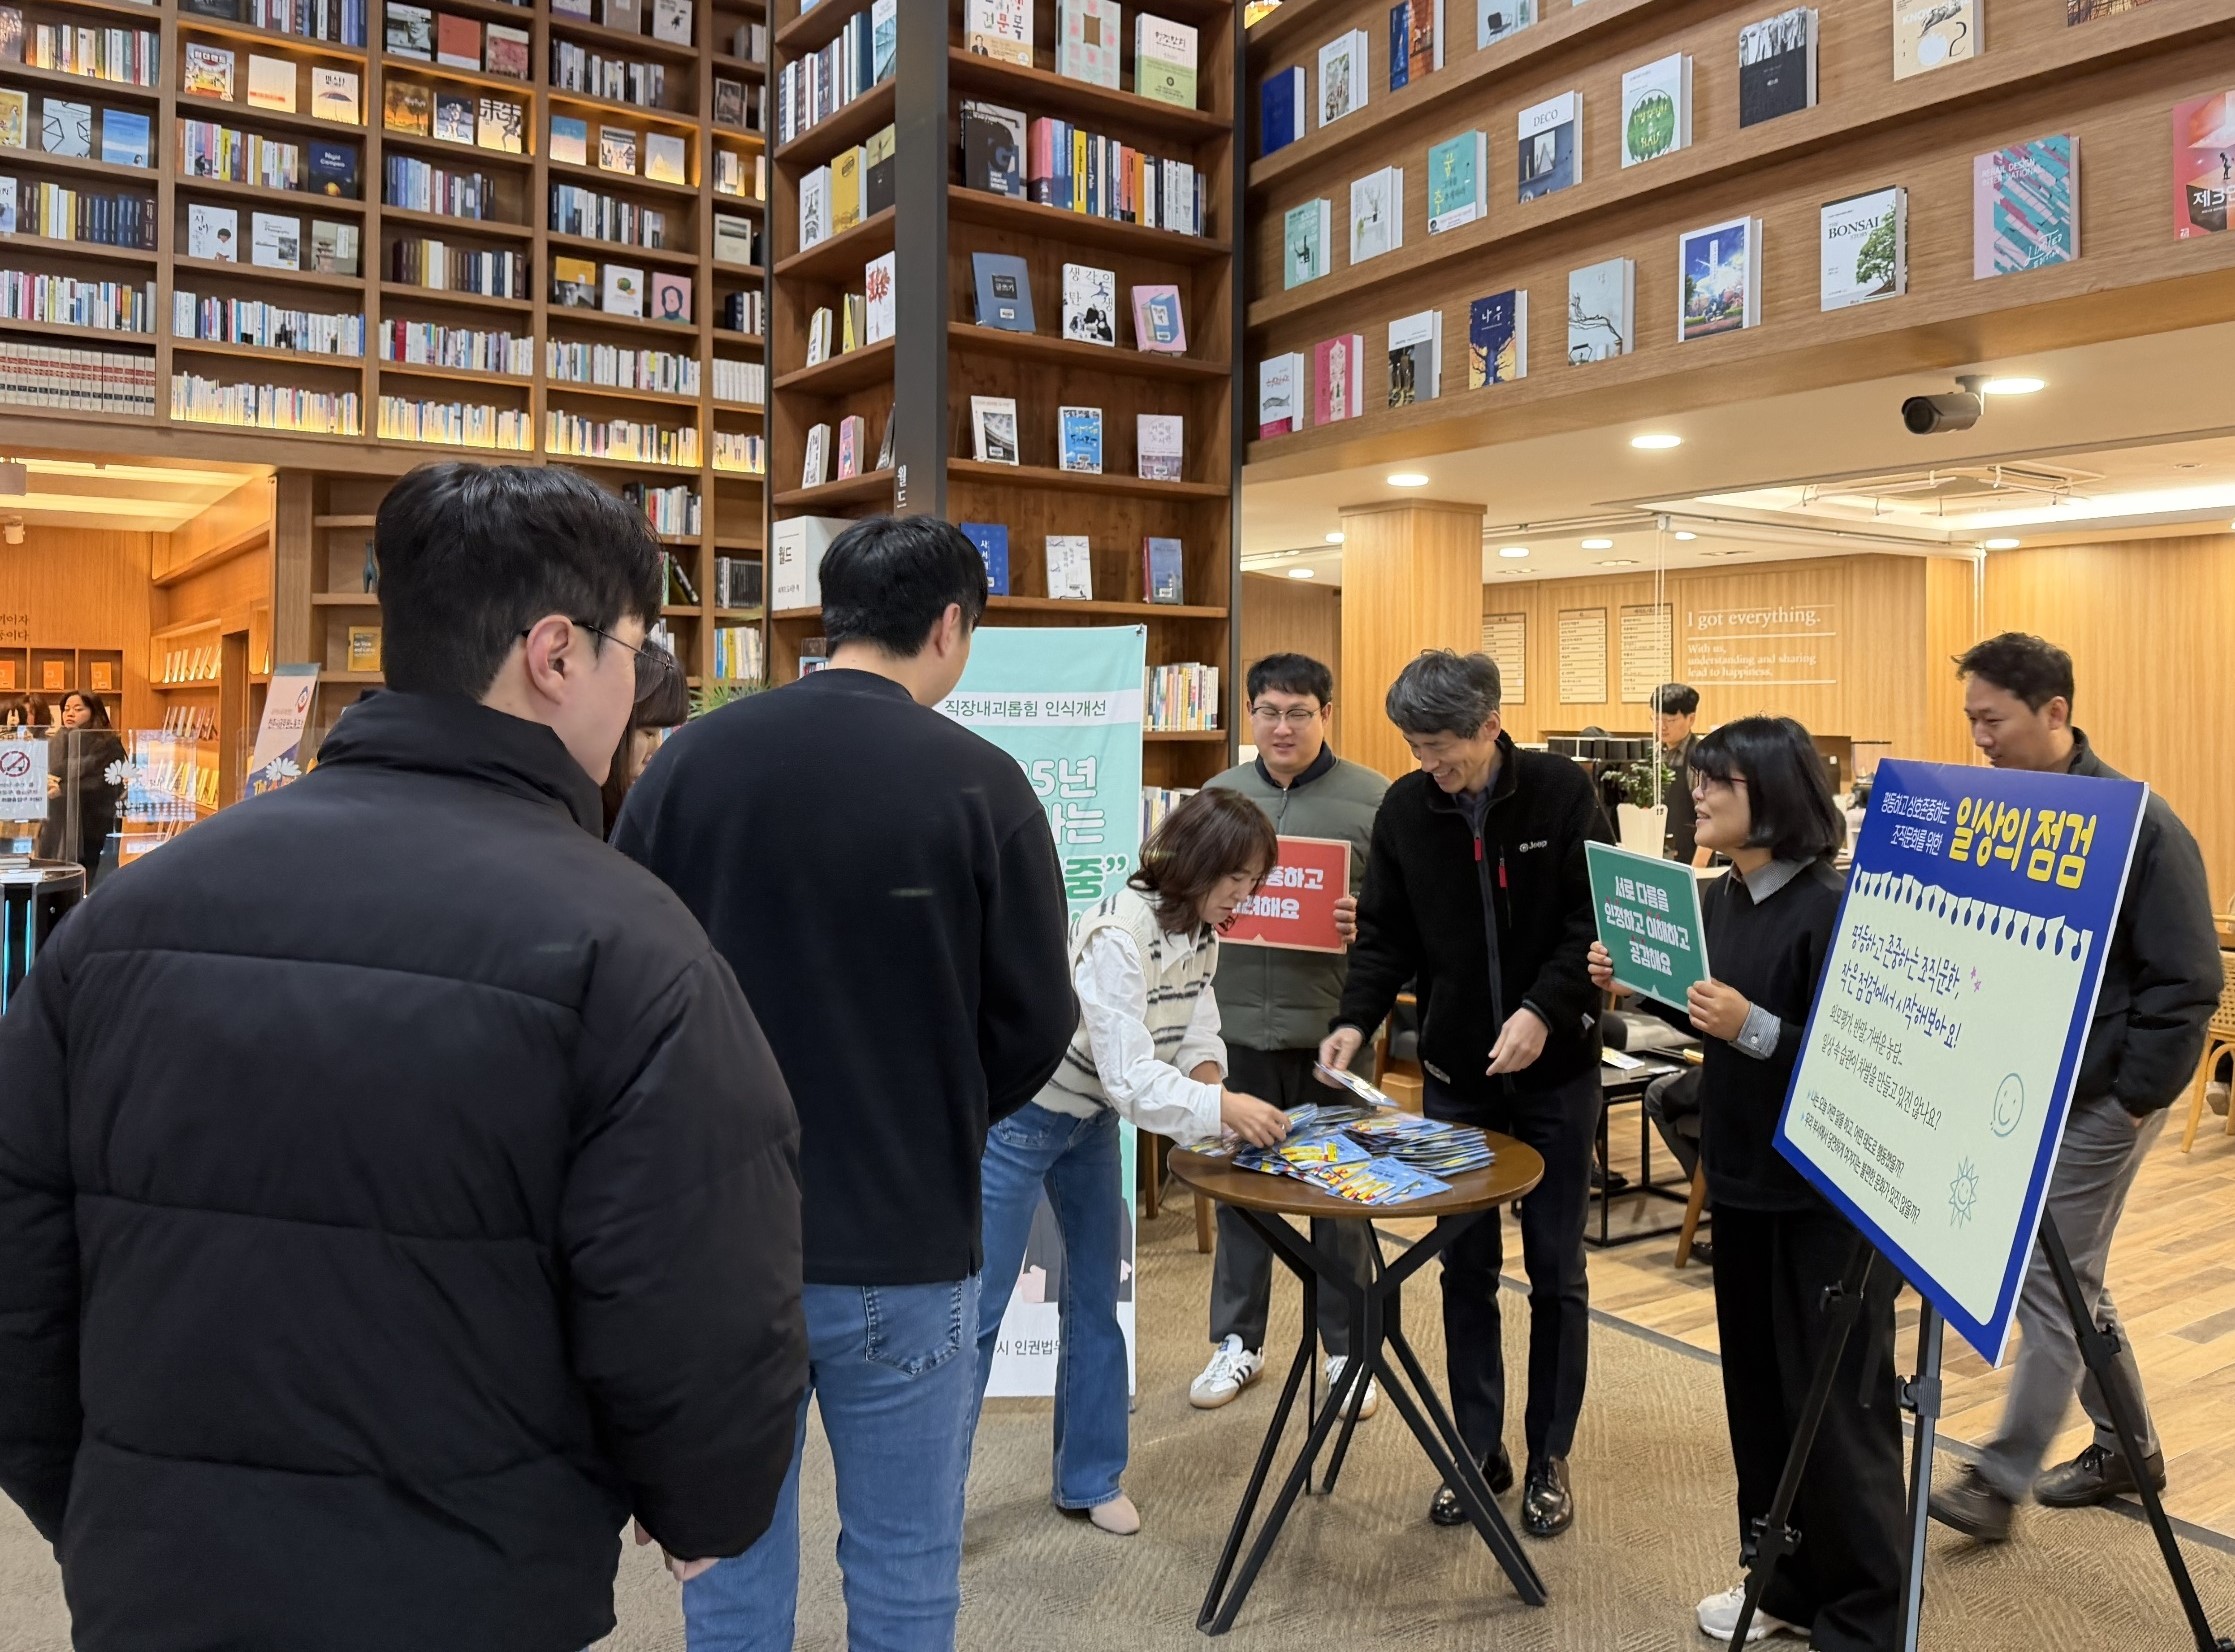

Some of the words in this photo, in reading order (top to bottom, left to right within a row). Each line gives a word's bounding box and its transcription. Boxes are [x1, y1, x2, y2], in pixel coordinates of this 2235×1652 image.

[1533, 109, 1559, 127] DECO
[2008, 158, 2035, 171] DESIGN
[1828, 216, 1879, 239] BONSAI
[1069, 267, 1113, 285] 생각의
[1069, 291, 1112, 312] 탄생
[778, 546, 792, 565] 월드
[1688, 611, 1693, 627] I
[1698, 612, 1723, 630] got
[1729, 606, 1821, 628] everything.
[1688, 643, 1710, 654] With
[1688, 654, 1755, 665] understanding
[1757, 654, 1775, 664] and
[1779, 654, 1816, 666] sharing
[1688, 668, 1707, 677] lead
[1710, 668, 1720, 677] to
[1722, 667, 1774, 679] happiness.
[945, 699, 1038, 717] 직장내괴롭힘
[1045, 699, 1106, 717] 인식개선
[1882, 792, 1909, 815] 평등하고
[1891, 825, 1927, 851] 조직문화를
[1926, 832, 1943, 855] 위한
[1950, 796, 2031, 871] 일상의
[2027, 808, 2097, 889] 점검
[1266, 866, 1324, 890] 중하고
[1615, 875, 1636, 901] 서로
[1636, 881, 1669, 912] 다름을
[1604, 902, 1645, 935] 인정하고
[1646, 915, 1690, 951] 이해하고
[1629, 940, 1672, 976] 공감해요
[1852, 925, 1884, 960] 평등하고
[1883, 934, 1918, 980] 존중하는
[1918, 956, 1961, 1000] 조직문화,
[1841, 960, 1858, 994] 작은
[1856, 971, 1896, 1008] 점검에서
[1867, 1027, 1886, 1055] 가벼운
[1822, 1034, 1834, 1056] 일상
[1834, 1041, 1840, 1058] 속
[1839, 1046, 1859, 1073] 습관이
[1857, 1059, 1876, 1087] 차별을
[1877, 1072, 1898, 1099] 만들고
[1896, 1086, 1913, 1113] 있진
[1912, 1096, 1941, 1130] 않나요?
[1818, 1097, 1827, 1115] 오늘
[994, 1341, 1008, 1356] 시
